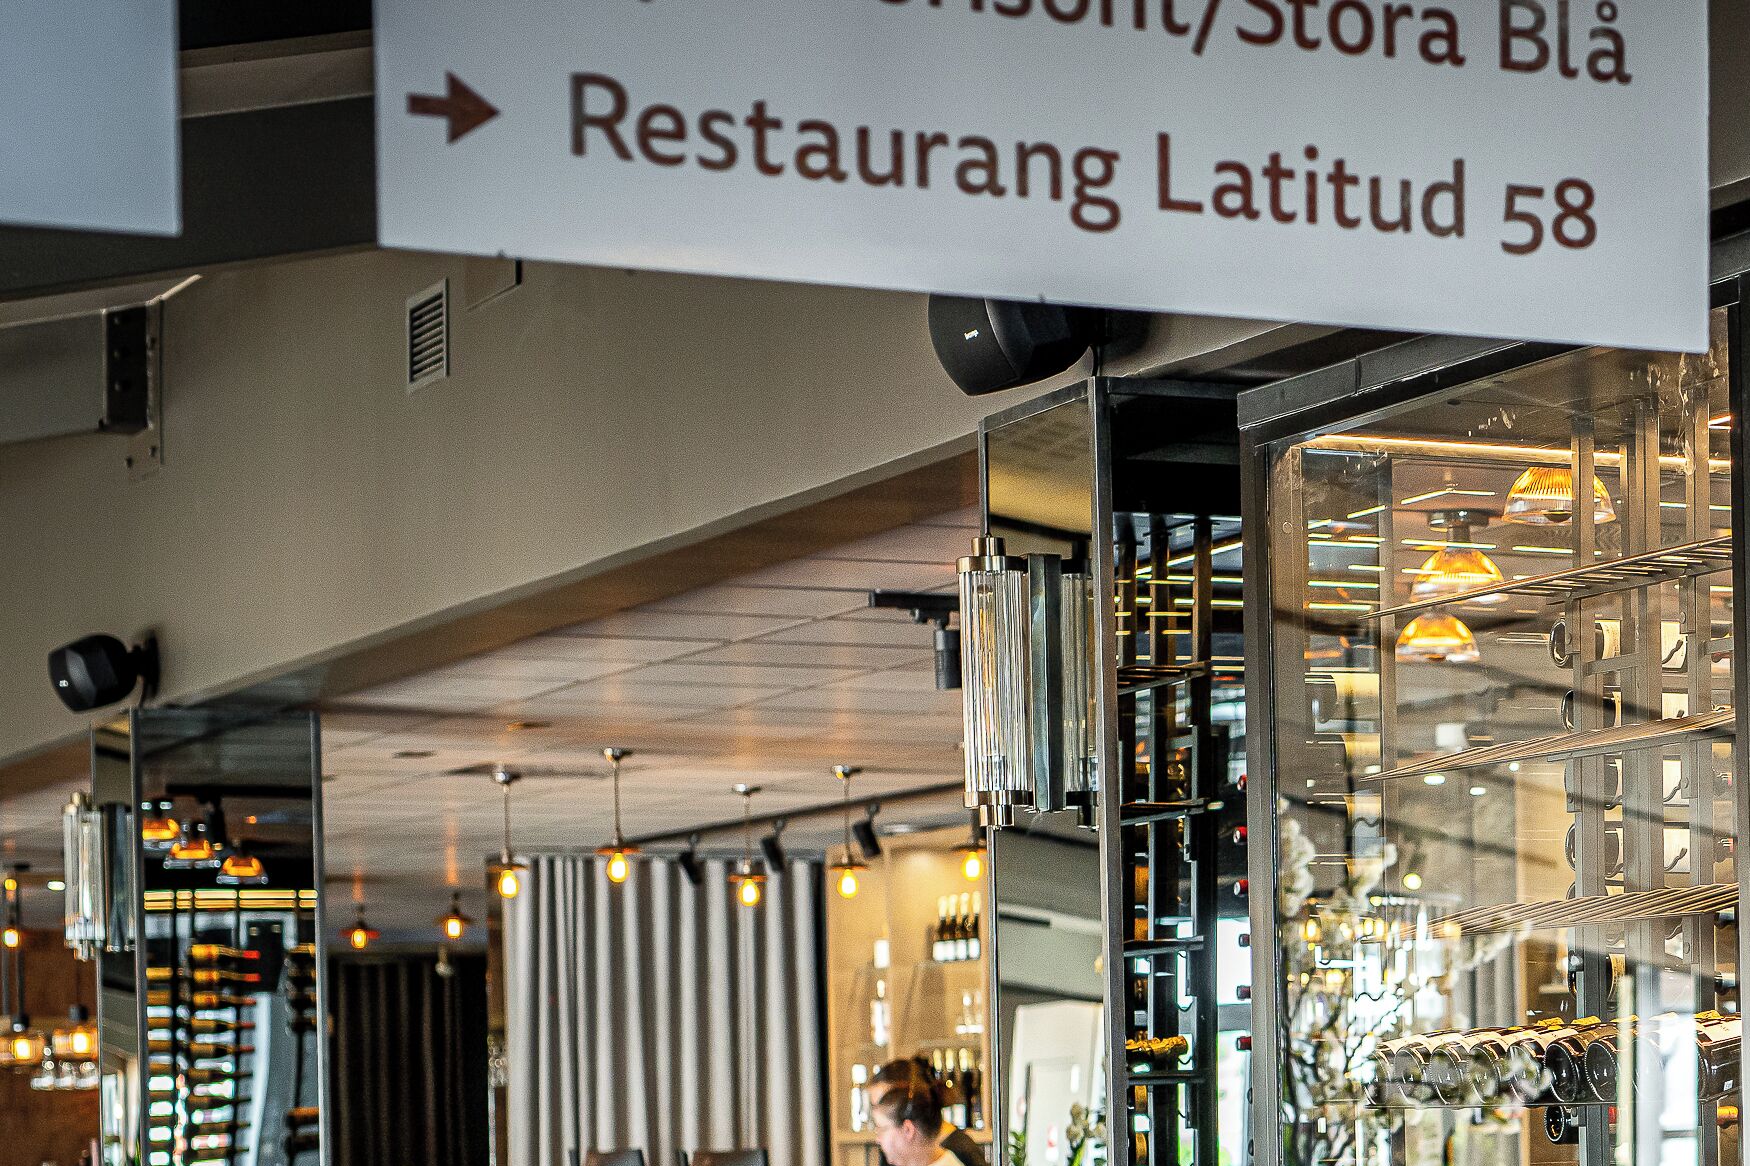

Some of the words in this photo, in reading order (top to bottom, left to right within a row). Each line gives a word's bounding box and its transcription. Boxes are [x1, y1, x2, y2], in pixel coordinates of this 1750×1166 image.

[569, 72, 1122, 233] Restaurang
[1156, 131, 1466, 239] Latitud
[1501, 178, 1598, 255] 58
